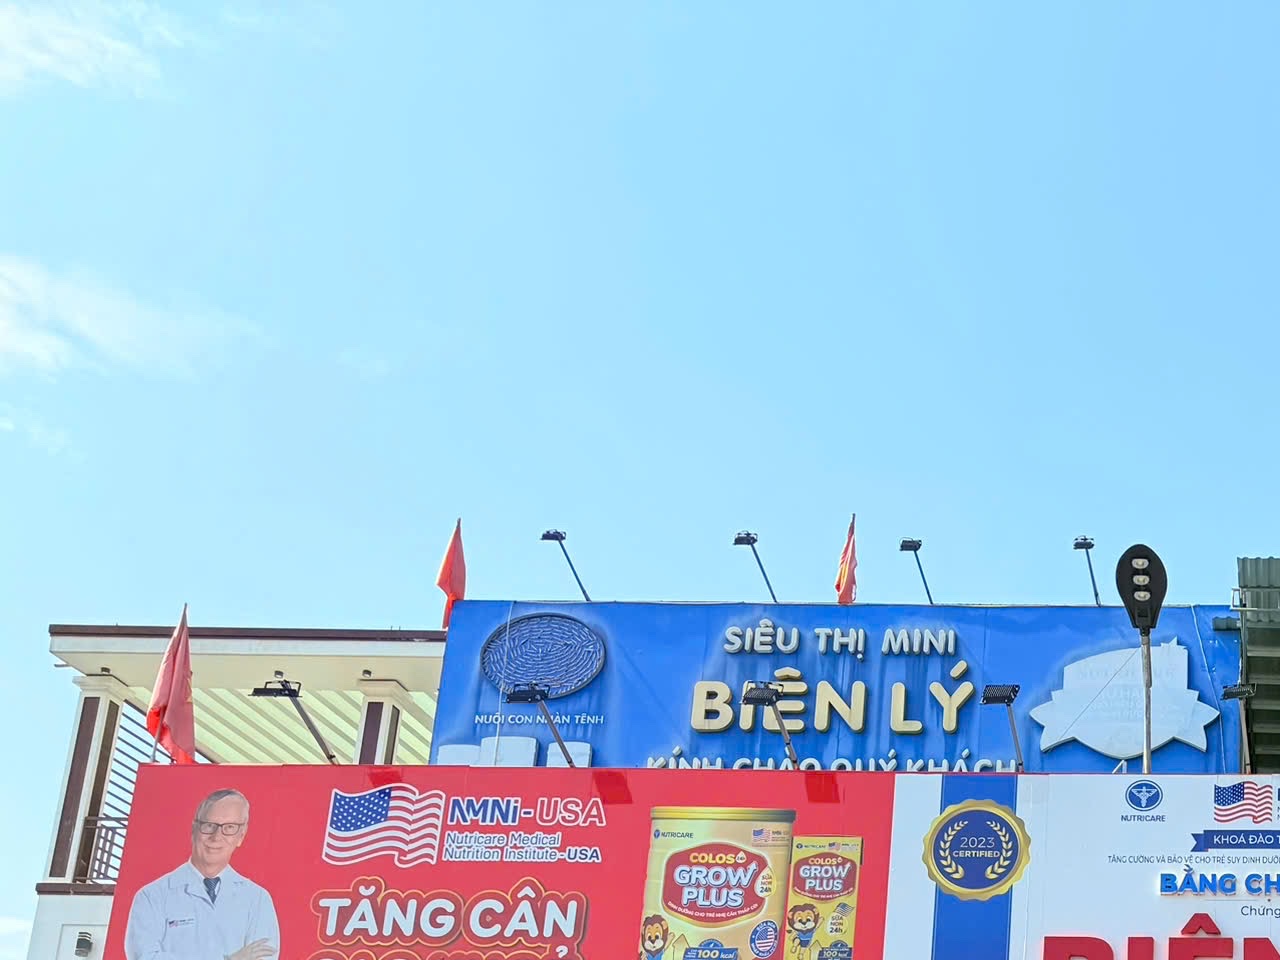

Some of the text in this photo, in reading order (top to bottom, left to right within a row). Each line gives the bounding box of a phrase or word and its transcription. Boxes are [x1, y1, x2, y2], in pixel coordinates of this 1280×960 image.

[723, 618, 956, 662] SIÊU THỊ MINI
[690, 659, 975, 735] BIÊN LÝ
[474, 712, 505, 724] NUÔI
[508, 715, 533, 724] CON
[445, 831, 562, 846] Nutricare Medical
[959, 836, 995, 848] 2023
[1213, 832, 1247, 845] KHOÁ
[1249, 832, 1274, 845] ĐÀO
[443, 847, 501, 862] Nutrition
[689, 852, 736, 864] COLOS
[952, 849, 1000, 858] CERTIFIED
[673, 861, 758, 888] GROW
[799, 862, 851, 878] GROW
[805, 879, 843, 891] PLUS
[1160, 864, 1236, 896] BẰNG
[682, 886, 744, 908] PLUS
[319, 886, 578, 938] TĂNG CÂN
